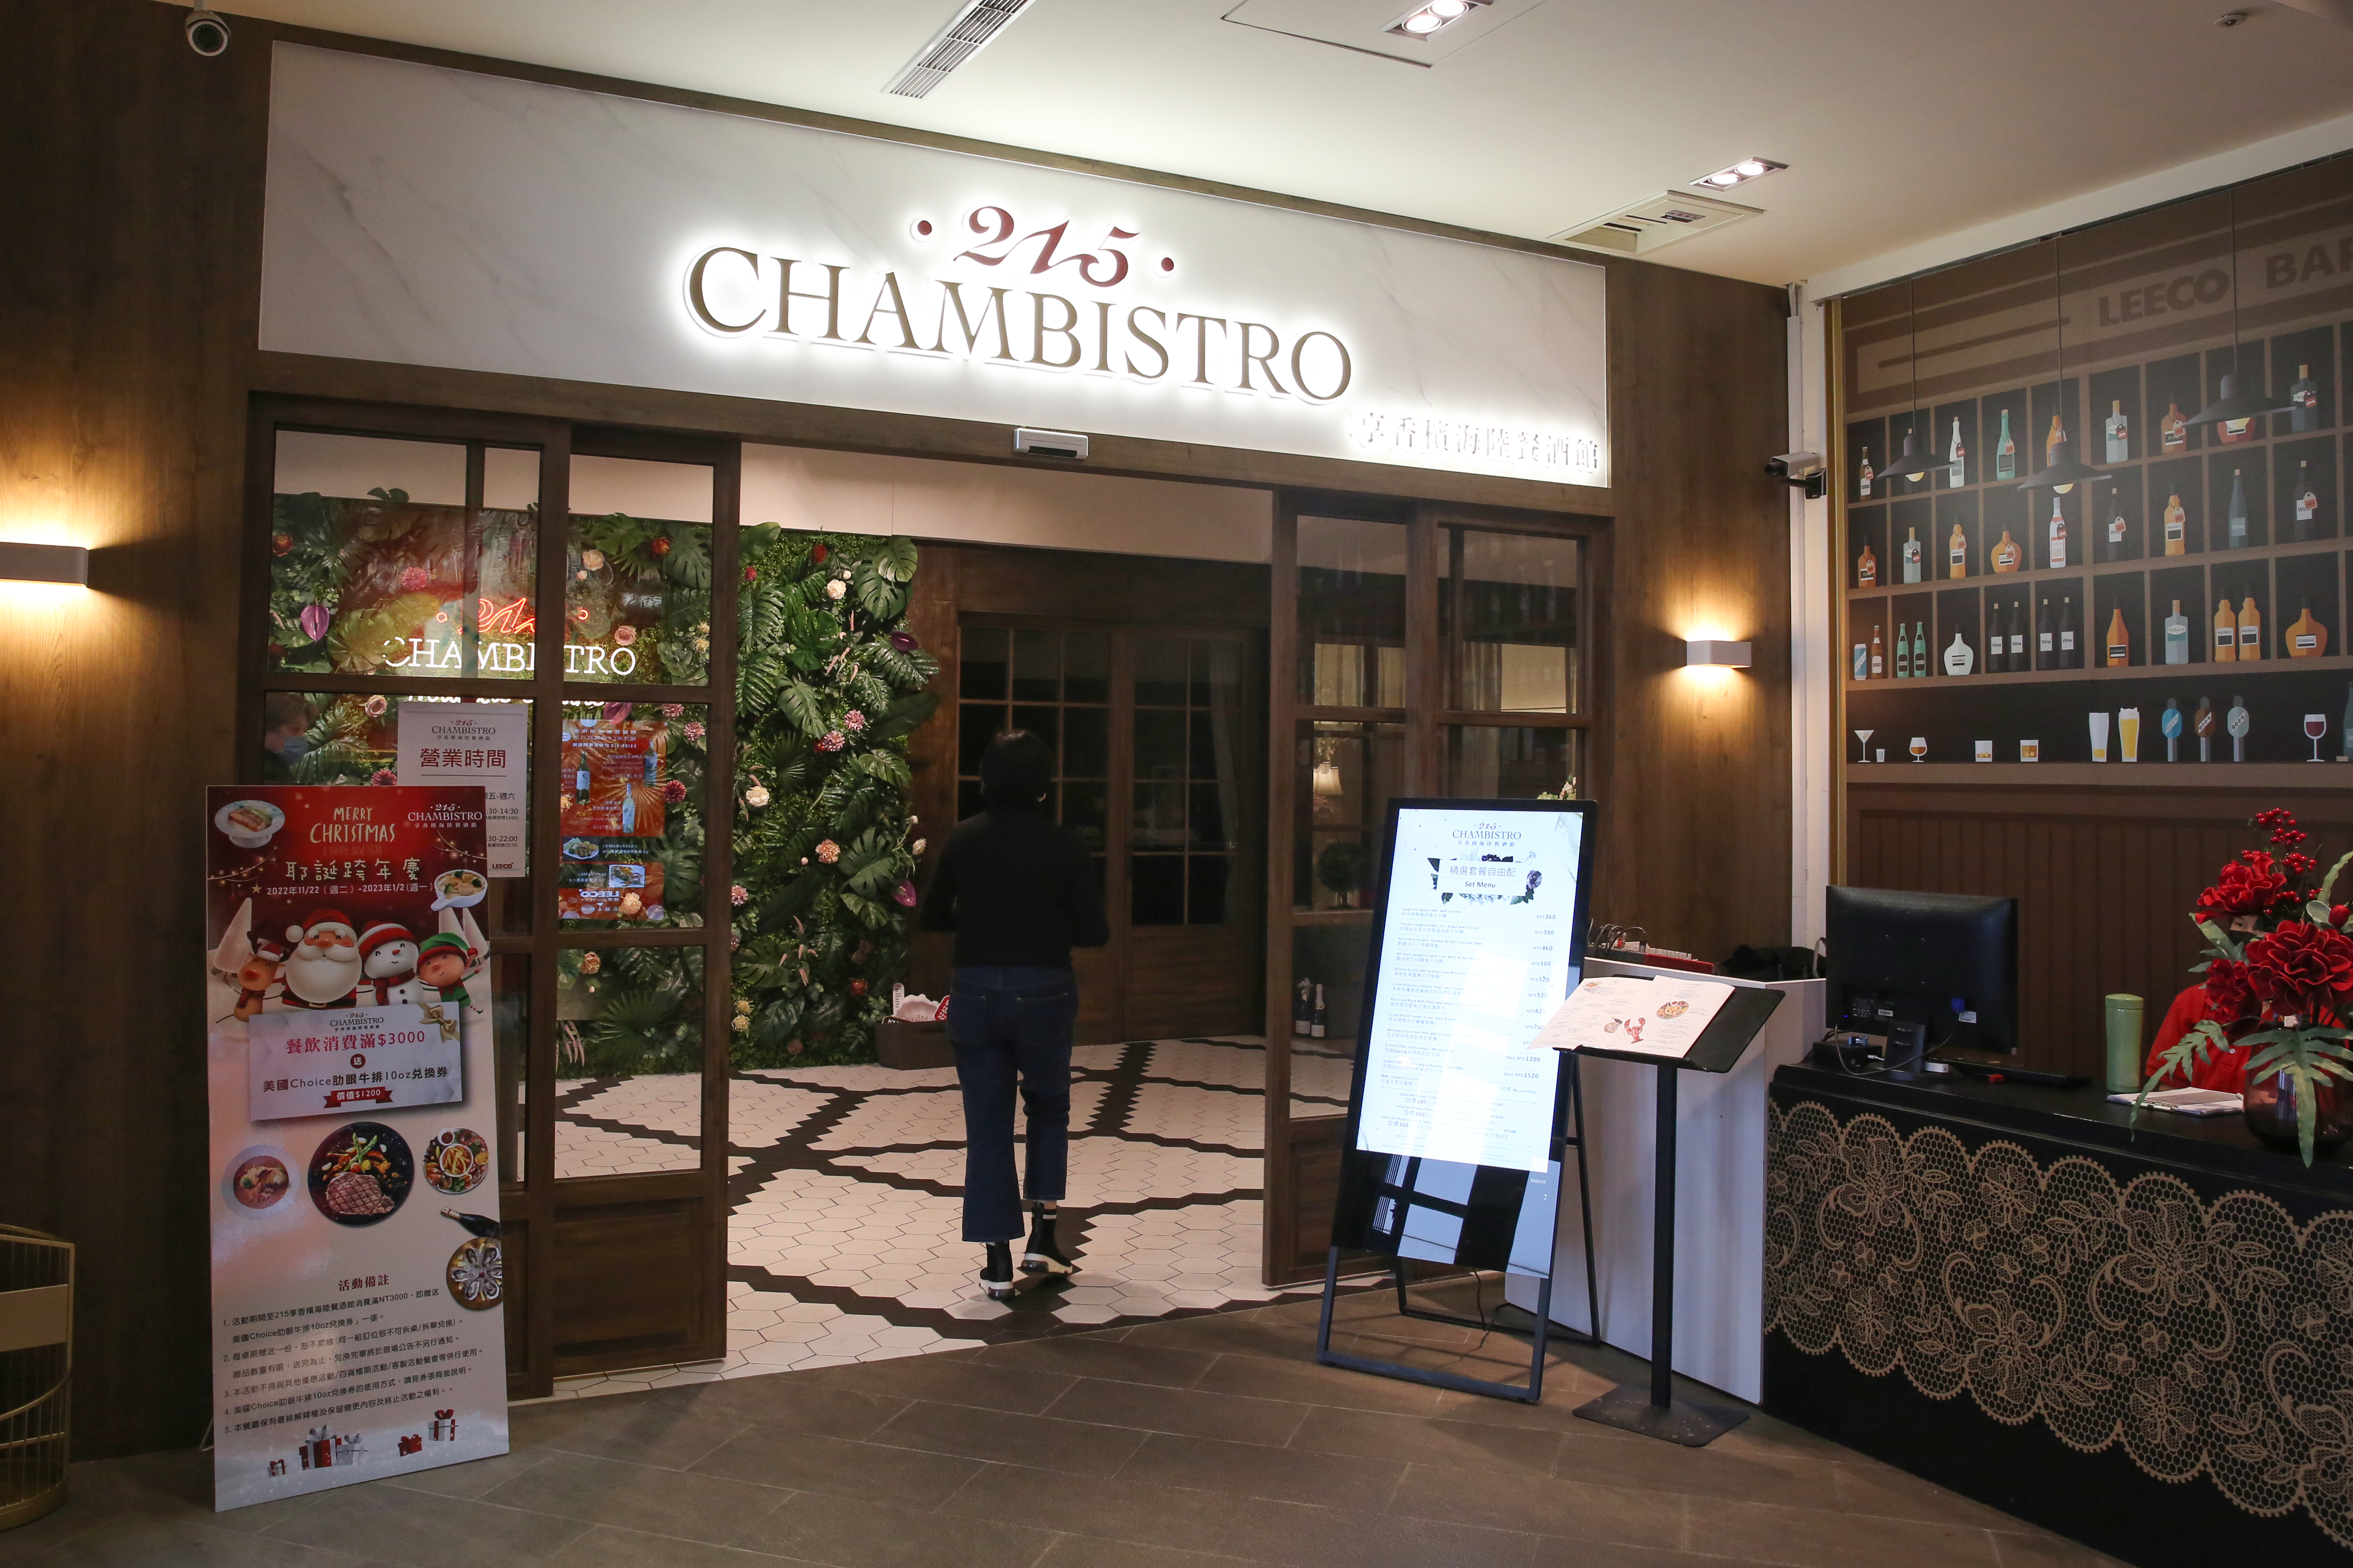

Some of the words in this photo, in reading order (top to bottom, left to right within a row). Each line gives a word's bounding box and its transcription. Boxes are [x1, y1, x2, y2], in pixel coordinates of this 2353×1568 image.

[954, 206, 1140, 288] 215
[2099, 269, 2230, 327] LEECO
[688, 246, 1352, 401] CHAMBISTRO
[382, 636, 636, 675] CHAMBITRO
[2198, 716, 2211, 730] BEER
[2232, 715, 2244, 729] BEER
[432, 726, 496, 735] CHAMBISTRO
[420, 748, 506, 769] 營業時間
[334, 807, 373, 821] MERRY
[408, 812, 482, 821] CHAMBISTRO
[309, 823, 395, 843] CHRISTMAS
[1453, 830, 1521, 839] CHAMBISTRO
[286, 857, 420, 881] 耶誕跨年慶
[1450, 866, 1515, 877] 精選套餐自由配
[330, 1017, 384, 1027] CHAMBISTRO
[286, 1031, 425, 1054] 餐飲消費滿$3000
[353, 1056, 363, 1067] 送
[336, 1088, 381, 1101] 價值$1200
[339, 1274, 389, 1292] 活動備註
